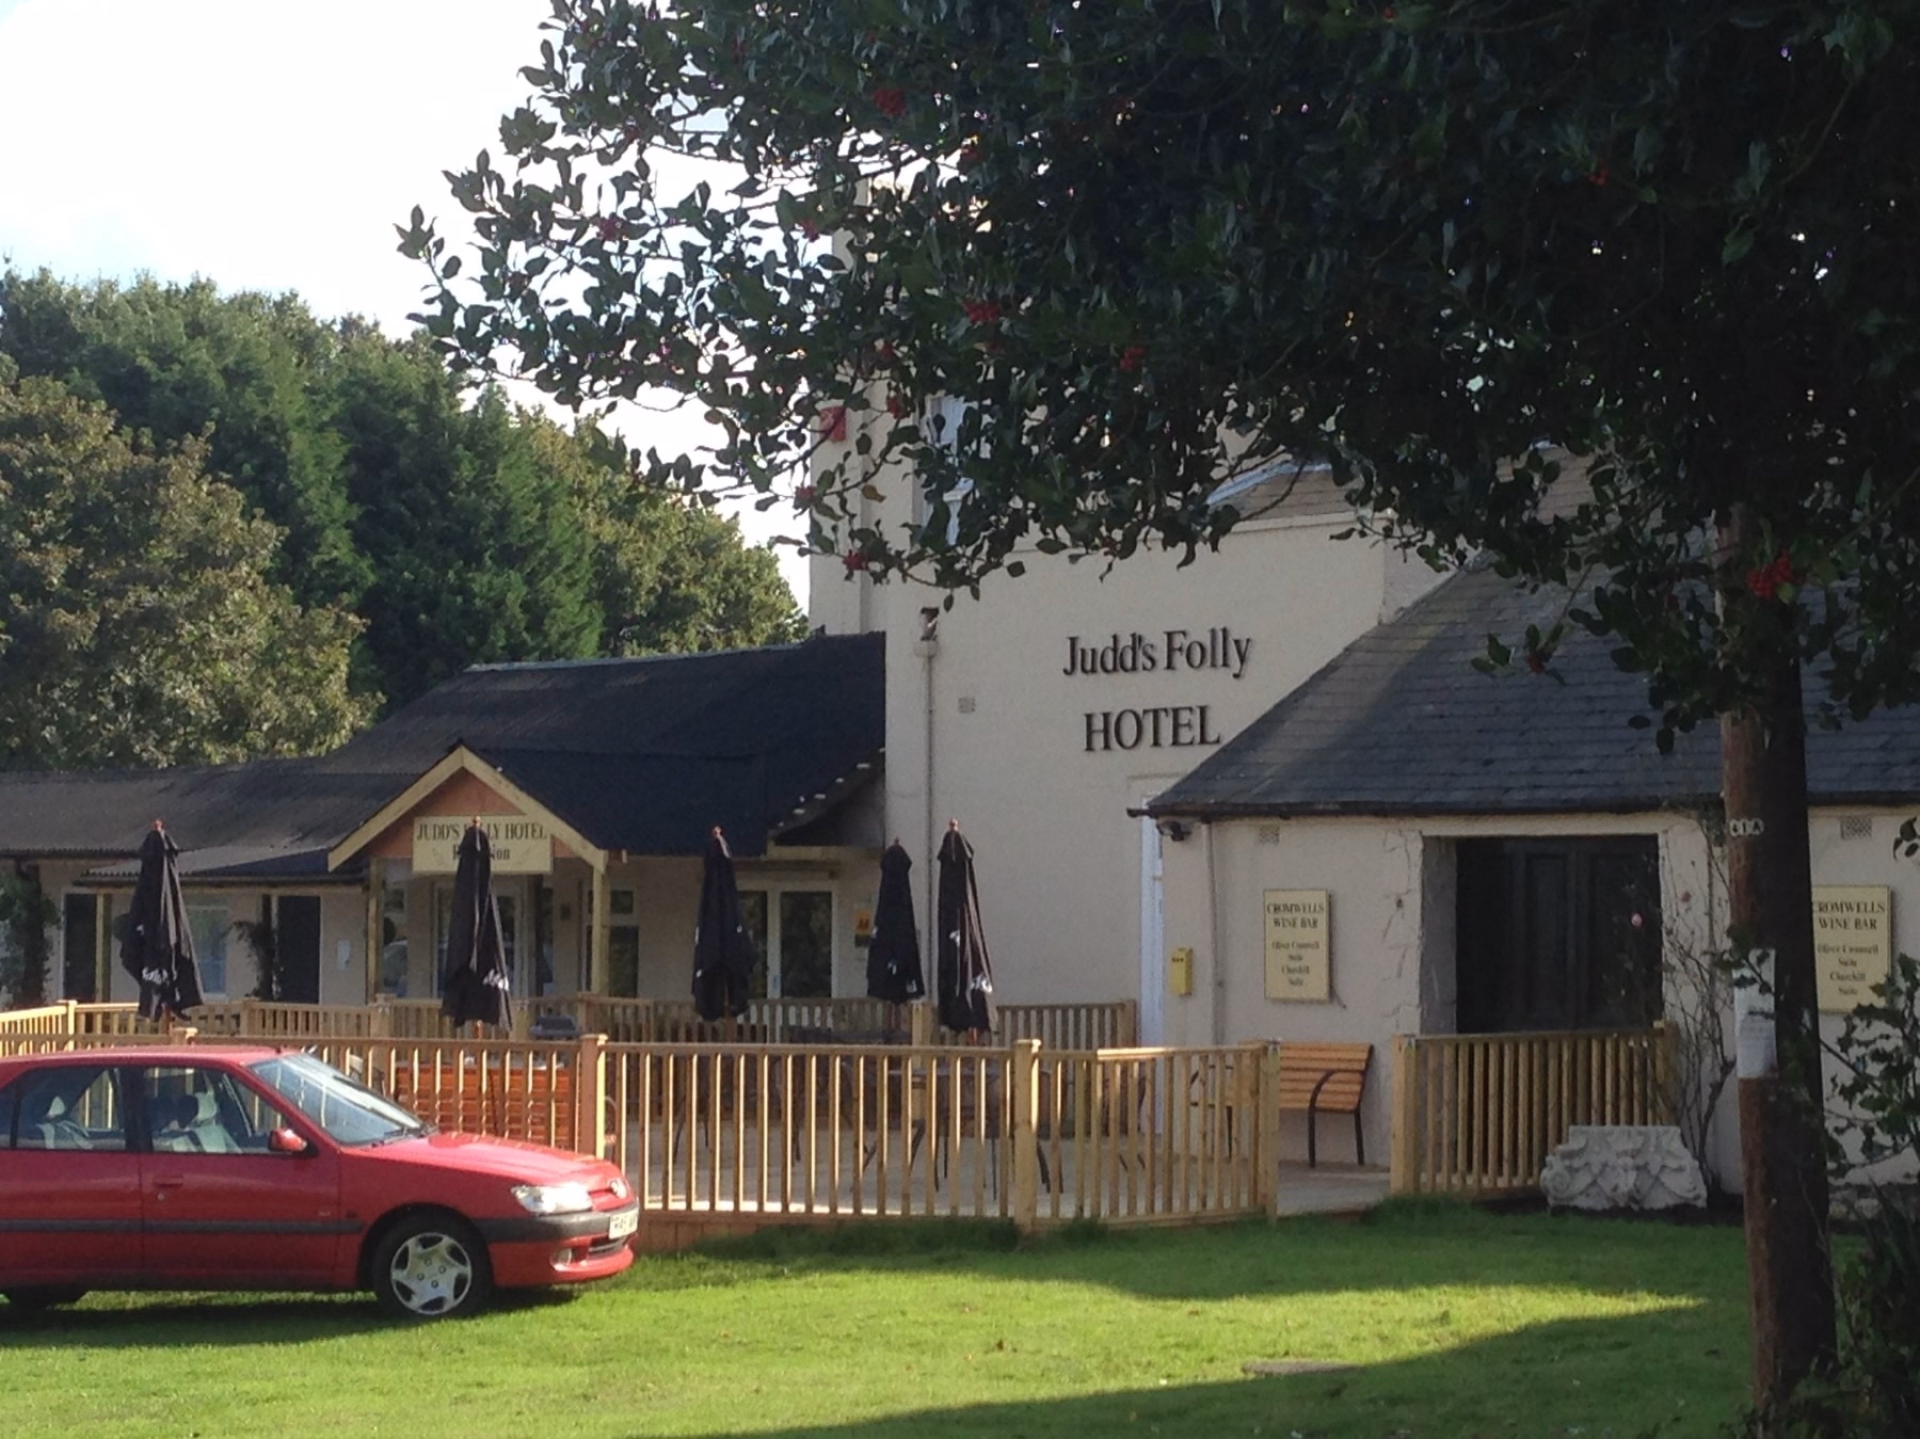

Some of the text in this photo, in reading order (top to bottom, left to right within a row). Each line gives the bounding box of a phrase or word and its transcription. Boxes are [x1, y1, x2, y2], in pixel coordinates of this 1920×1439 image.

[1063, 626, 1250, 679] Judd's Folly
[1084, 705, 1220, 751] HOTEL
[416, 823, 460, 841] JUDD'S
[505, 822, 547, 840] HOTEL
[1818, 918, 1877, 930] WINE BAR
